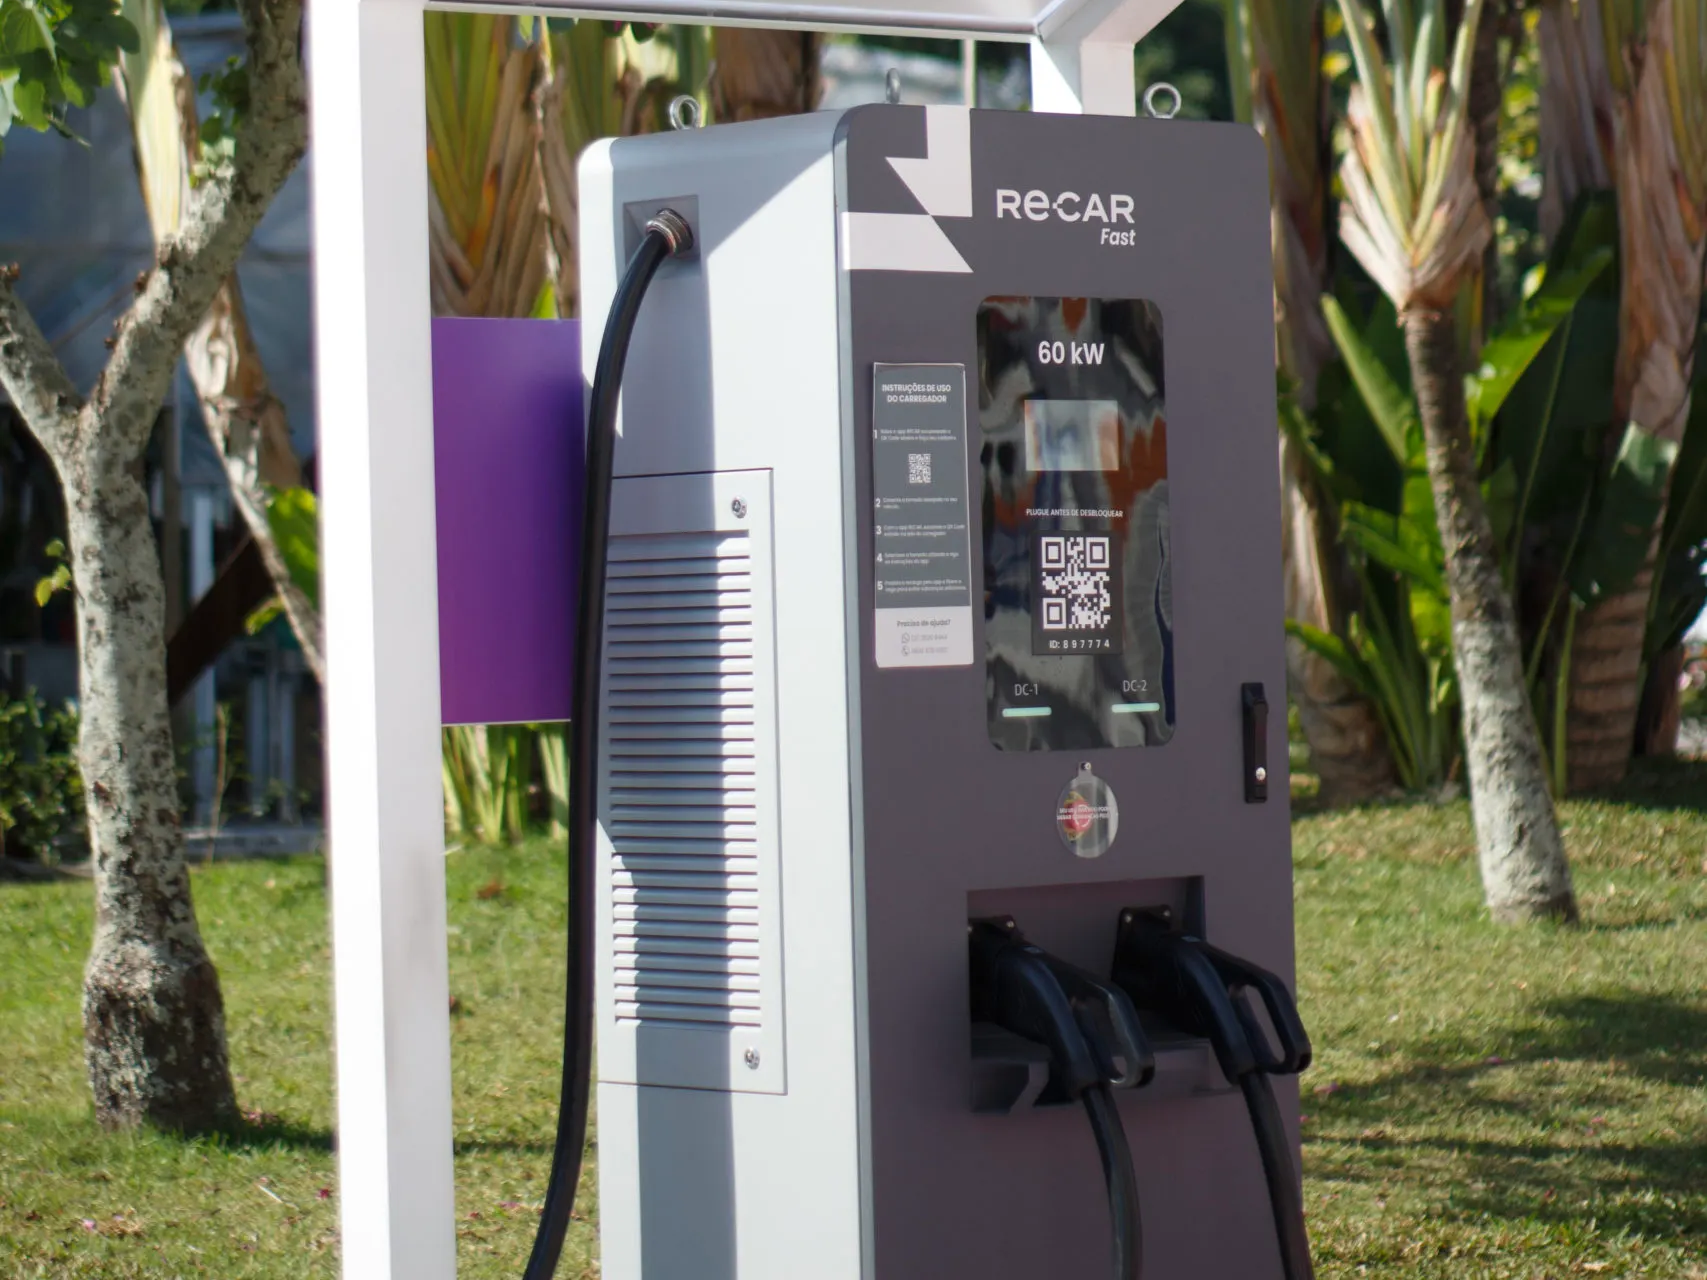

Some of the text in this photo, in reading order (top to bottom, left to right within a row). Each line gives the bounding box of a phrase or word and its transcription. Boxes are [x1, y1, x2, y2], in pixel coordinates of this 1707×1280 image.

[1100, 228, 1136, 246] Fast
[1038, 341, 1105, 365] 60 kW
[882, 383, 952, 394] INSTRUÇÕES DE USO
[887, 395, 947, 403] DO CARREGADOR
[875, 497, 881, 508] 2
[1026, 508, 1123, 518] PLUGUE ANTES DE DESBLOQUEAR
[876, 524, 882, 535] 3
[876, 552, 883, 562] 4
[877, 580, 883, 591] 5
[1014, 683, 1039, 696] DC-1
[1122, 679, 1147, 693] DC-2
